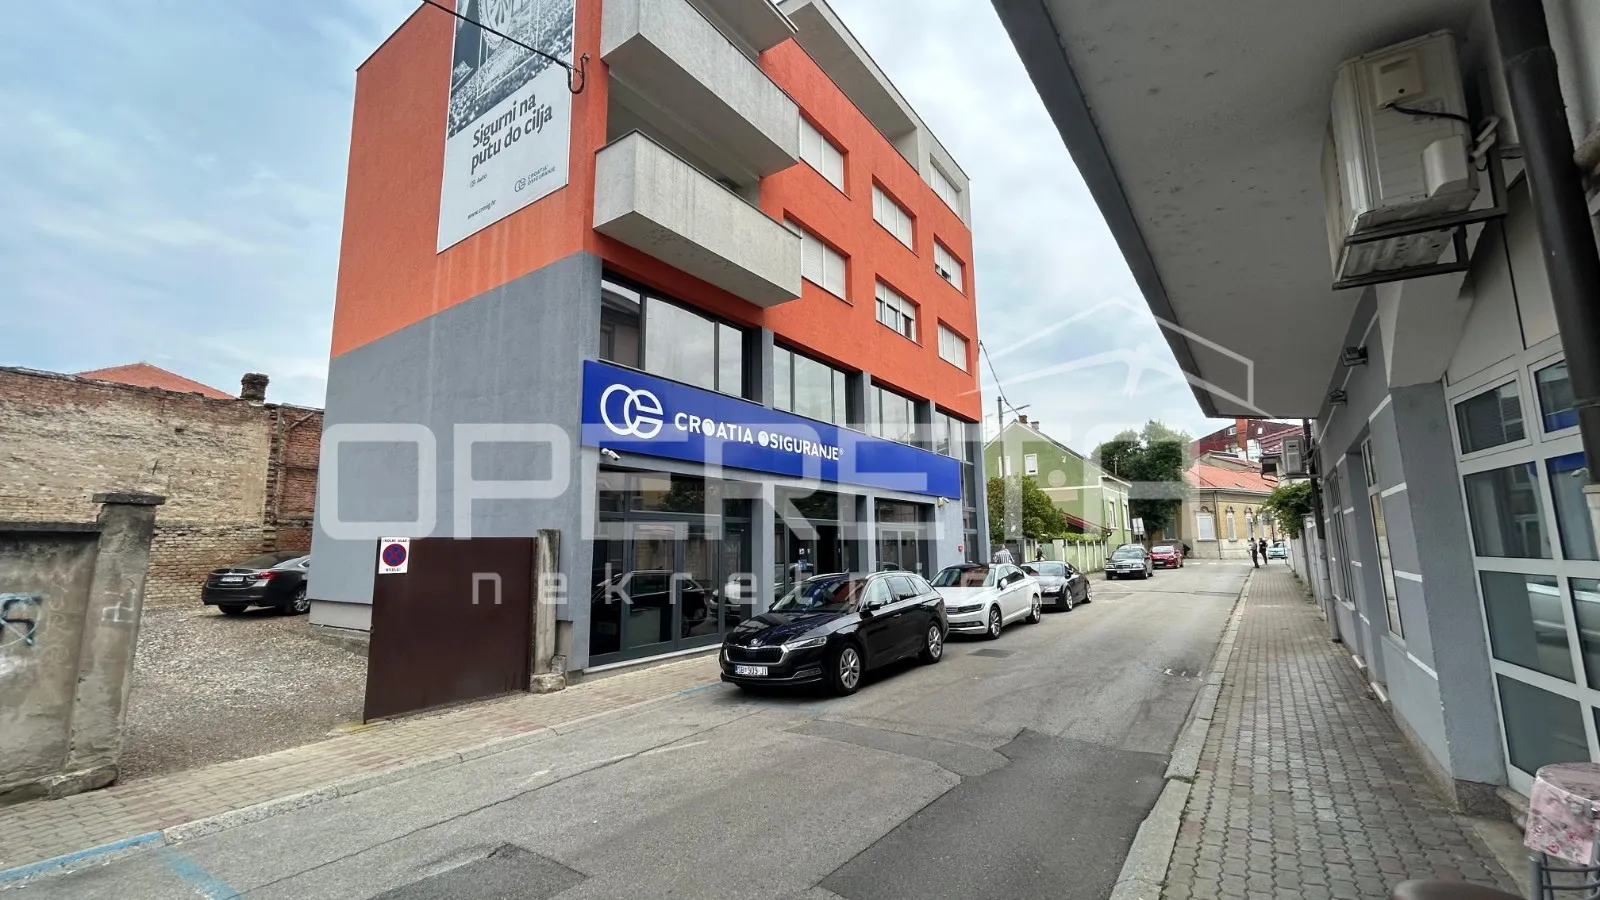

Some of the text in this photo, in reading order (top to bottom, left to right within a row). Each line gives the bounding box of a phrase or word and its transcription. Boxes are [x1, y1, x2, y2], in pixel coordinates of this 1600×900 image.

[470, 103, 553, 175] putu do cilja
[472, 94, 536, 148] Sigurni na
[674, 412, 840, 461] CROATIA OSIGURANJE
